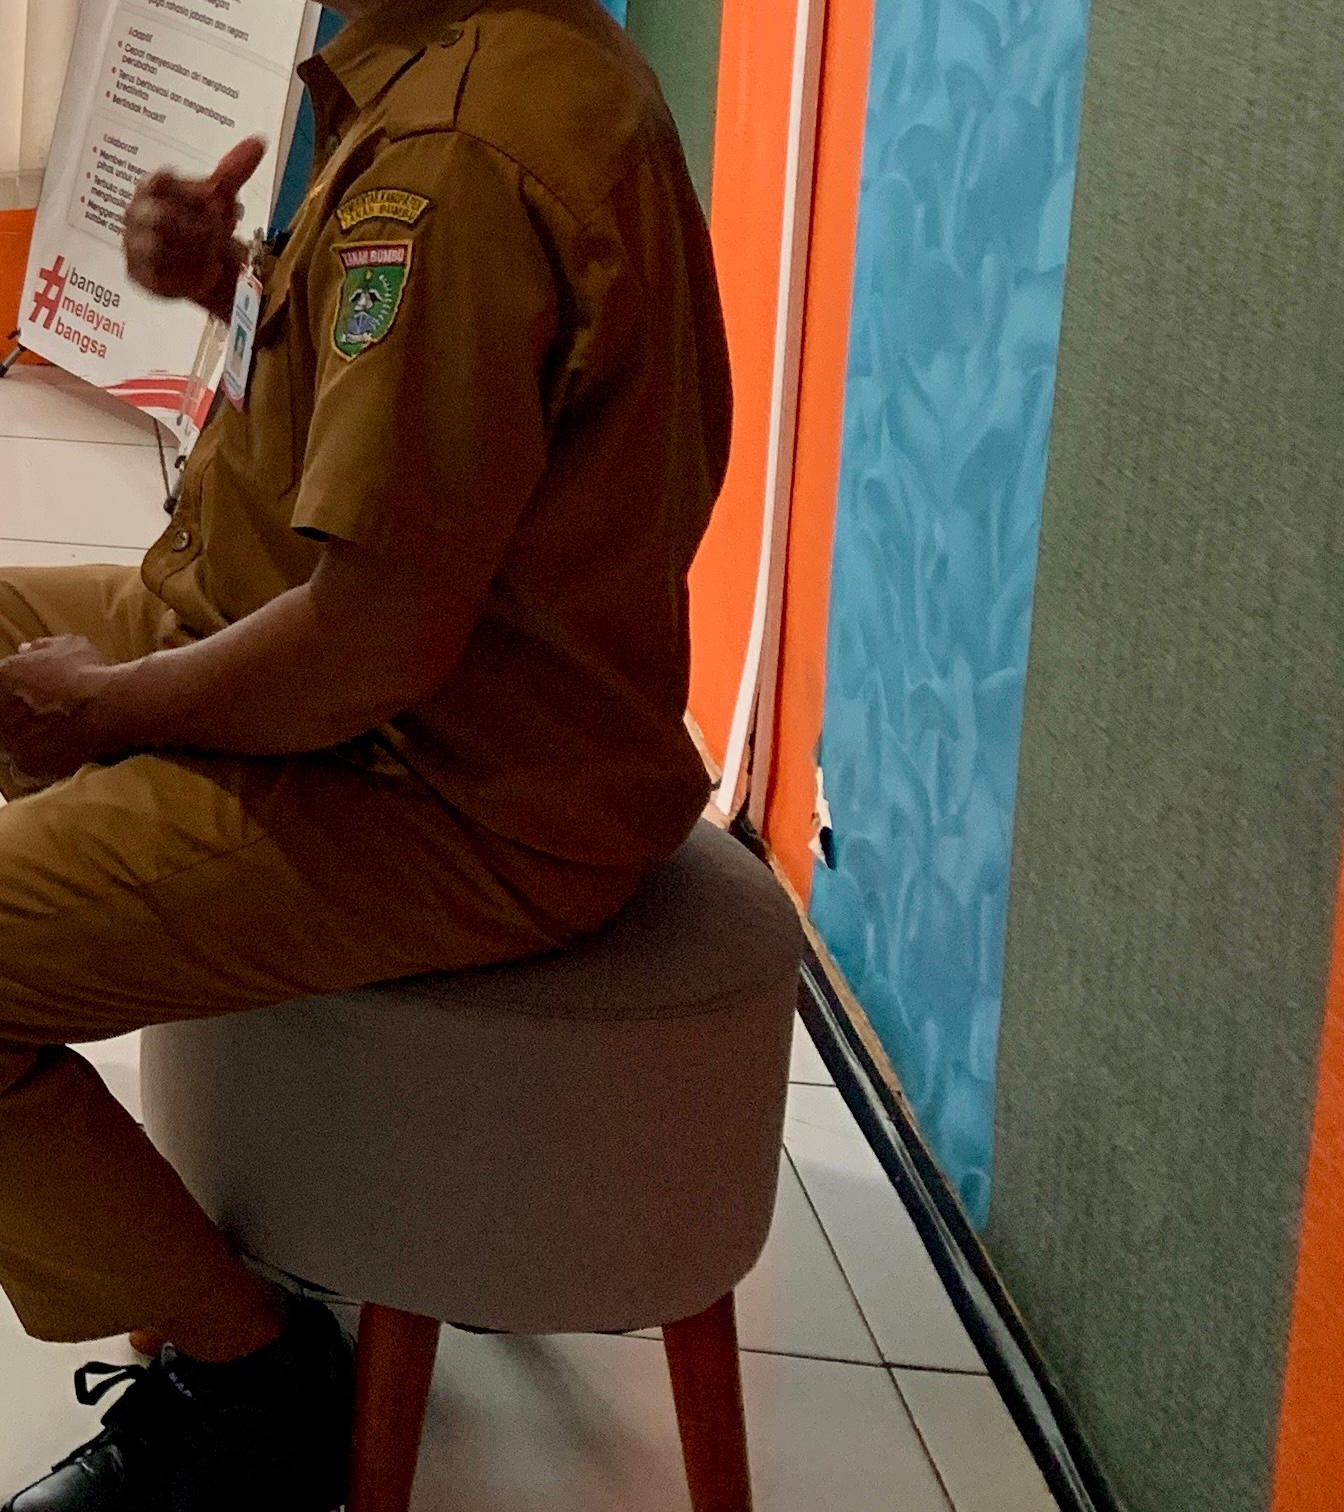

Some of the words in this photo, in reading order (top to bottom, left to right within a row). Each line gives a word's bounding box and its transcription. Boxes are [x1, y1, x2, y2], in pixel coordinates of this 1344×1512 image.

[70, 267, 121, 308] bangga
[62, 295, 126, 339] melayani
[54, 318, 108, 359] bangsa
